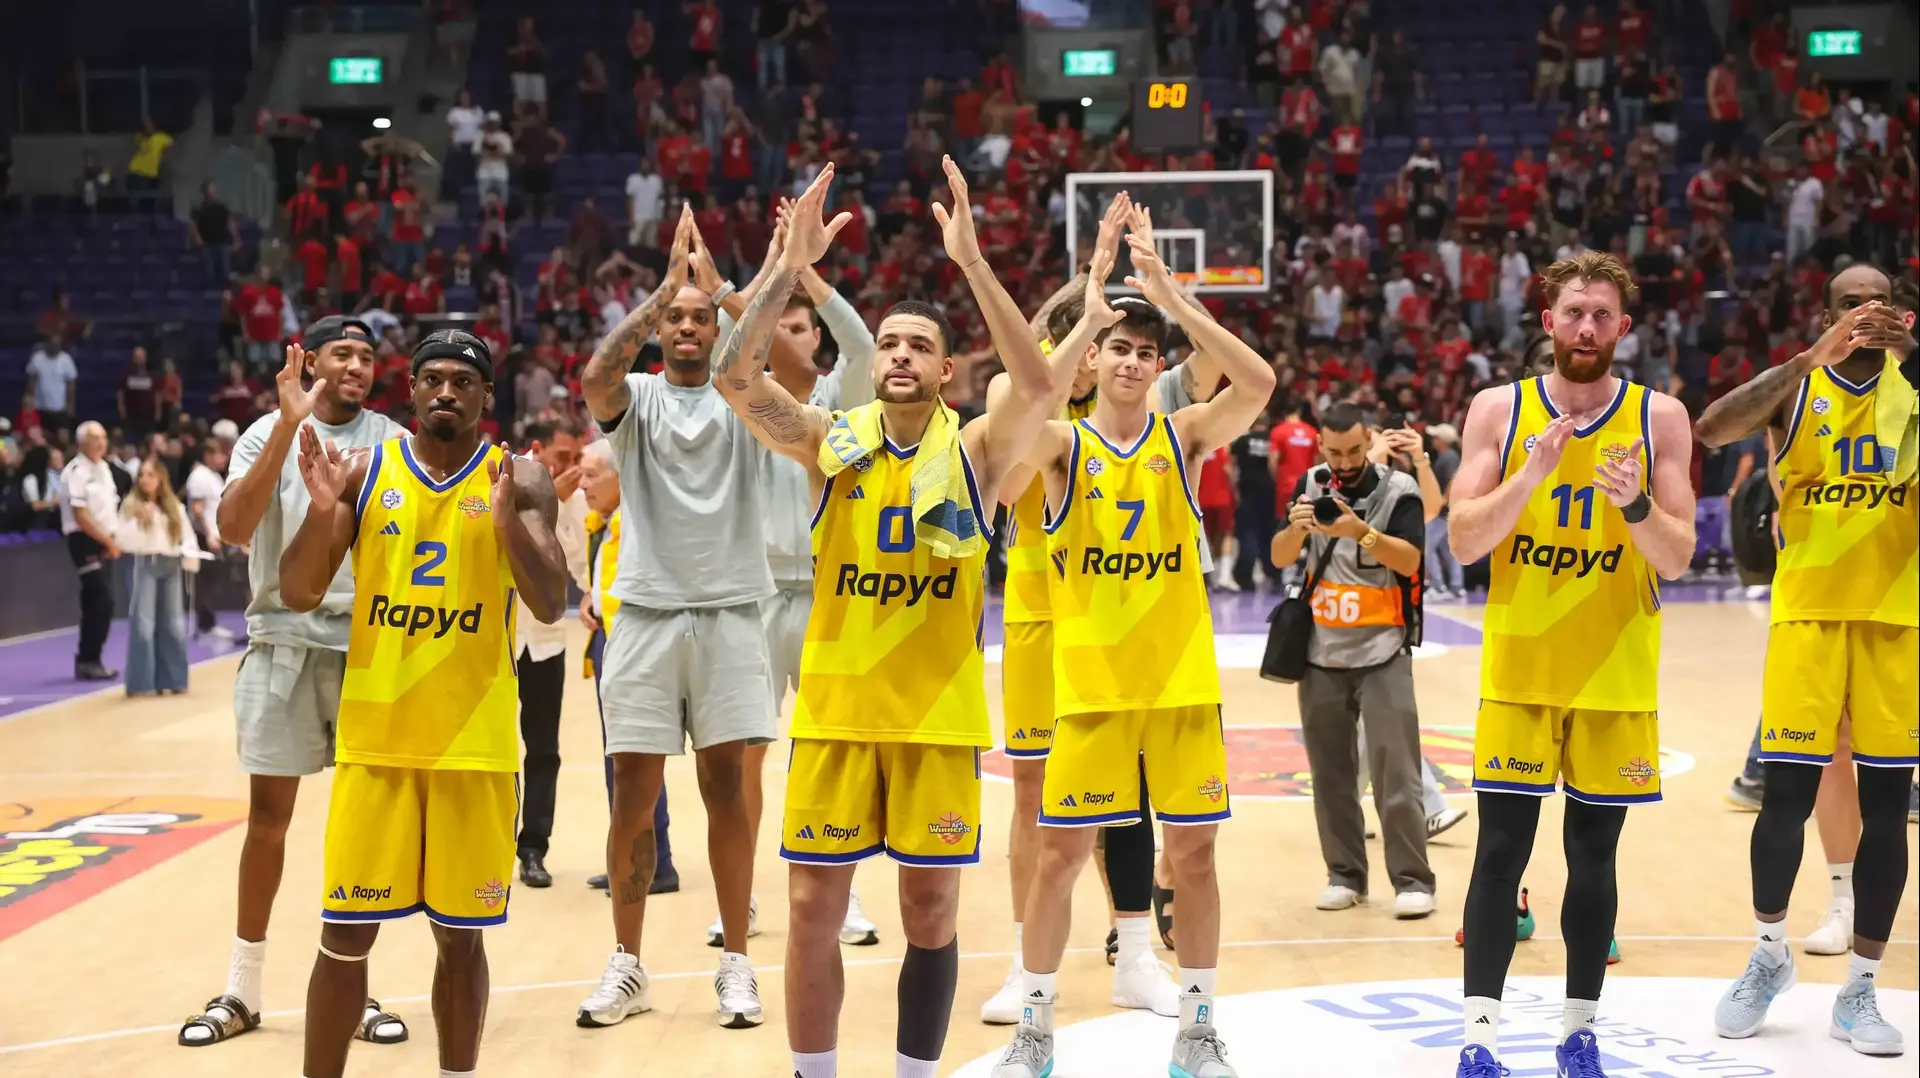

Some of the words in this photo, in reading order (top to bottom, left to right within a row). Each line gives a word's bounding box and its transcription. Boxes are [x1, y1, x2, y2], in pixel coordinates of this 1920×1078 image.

[1833, 434, 1884, 476] 10
[1116, 500, 1145, 541] 7
[1551, 483, 1595, 530] 11
[877, 506, 915, 553] 0
[411, 541, 447, 586] 2
[1081, 543, 1182, 581] Rapyd
[1509, 534, 1624, 579] Rapyd
[835, 563, 958, 607] Rapyd
[368, 595, 483, 639] Rapyd
[1311, 587, 1360, 624] 256
[1030, 727, 1052, 740] Rapy
[1780, 728, 1816, 743] Rapyd
[1506, 757, 1544, 774] Rapyd
[1083, 791, 1115, 805] Rapyd
[822, 824, 860, 841] Rapyd
[928, 823, 963, 833] Winner
[351, 885, 392, 902] Rapyd
[1667, 1051, 1776, 1078] UR
